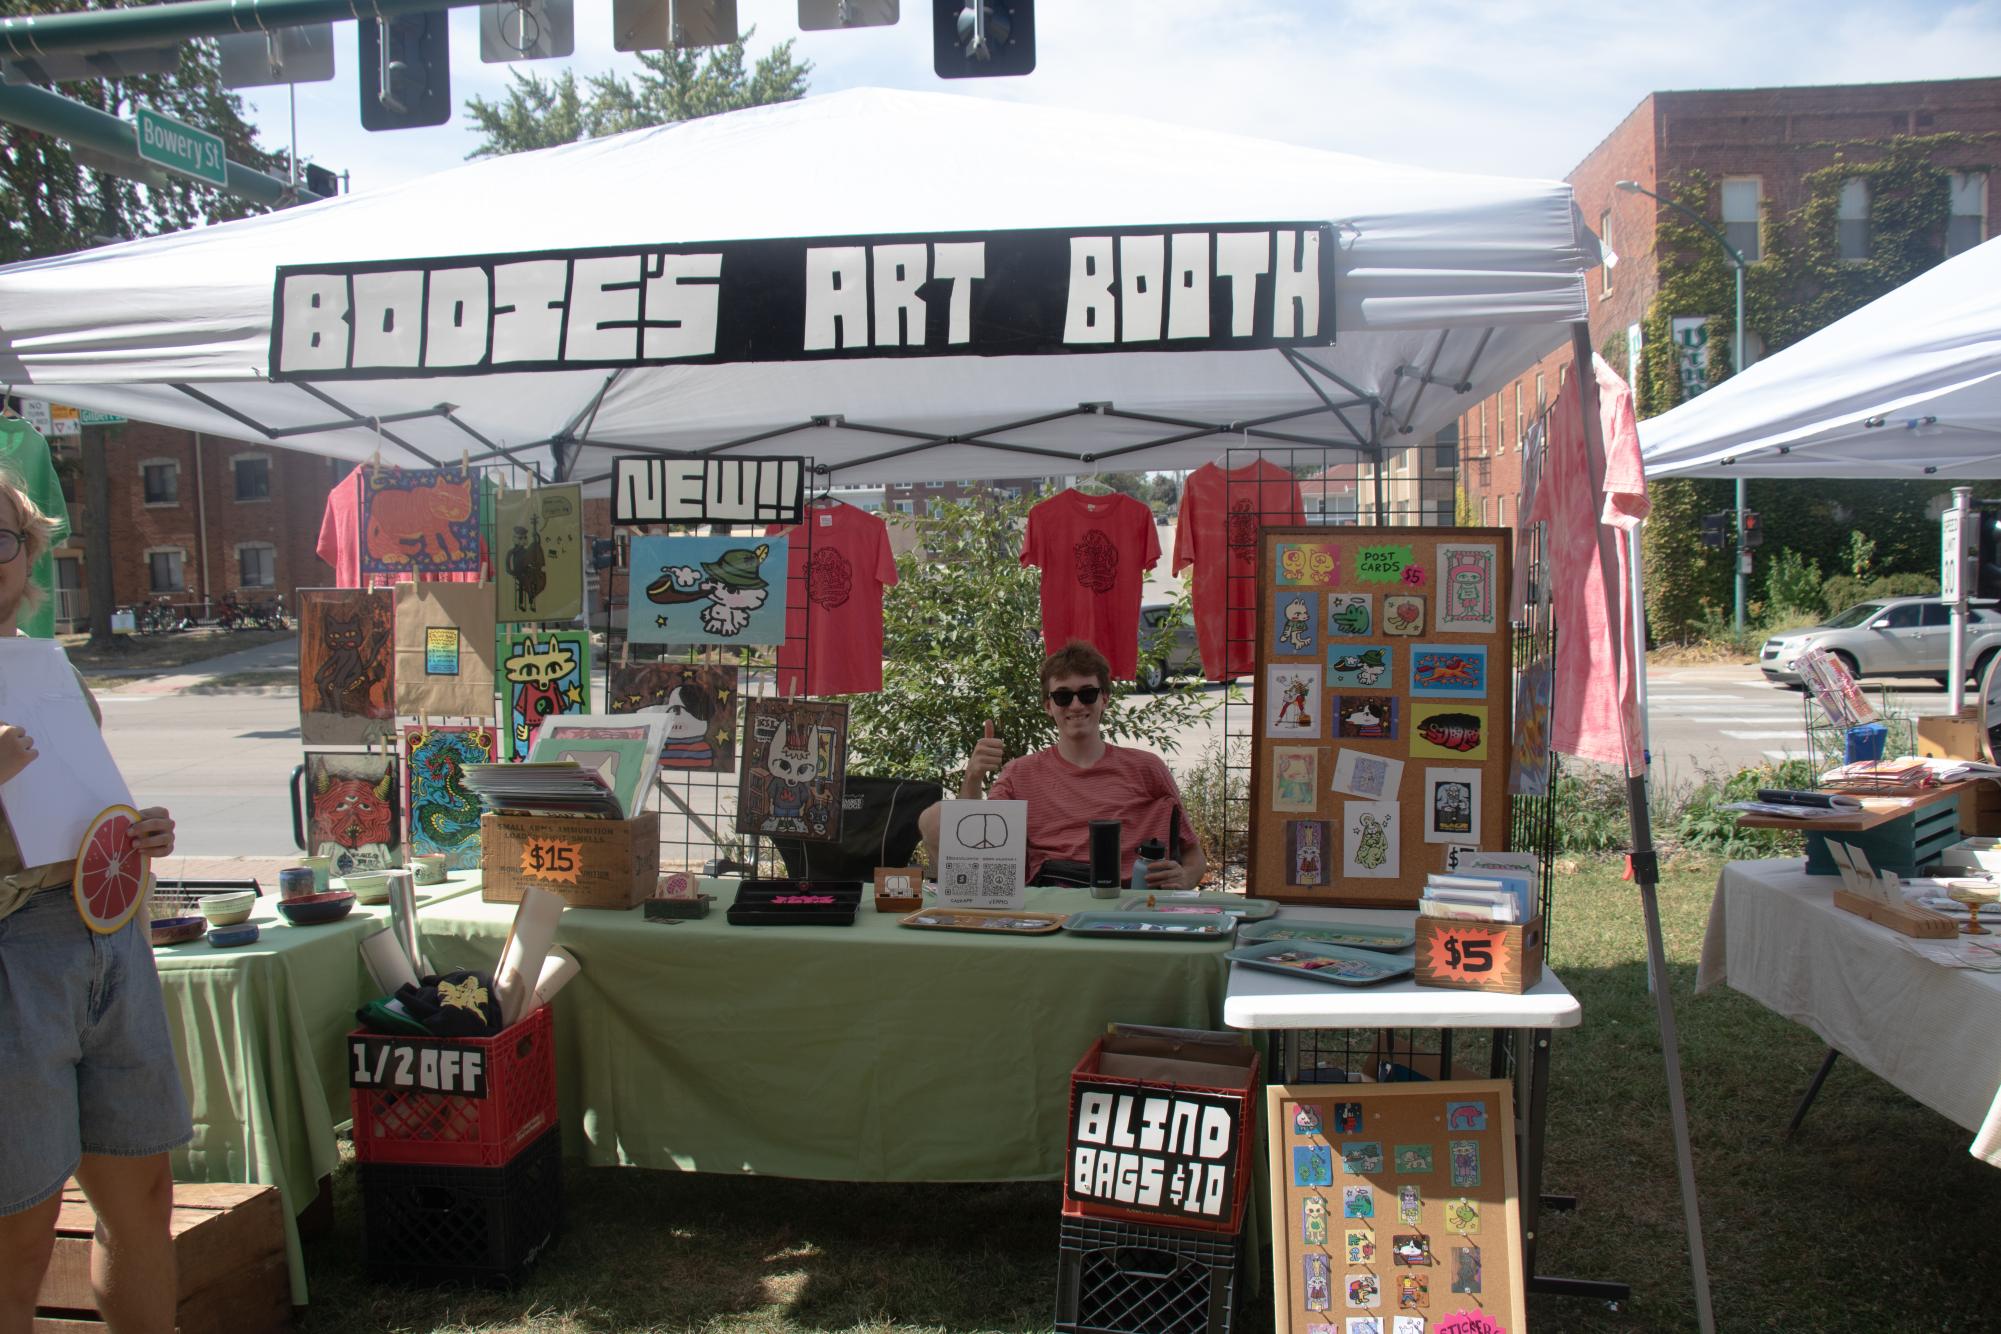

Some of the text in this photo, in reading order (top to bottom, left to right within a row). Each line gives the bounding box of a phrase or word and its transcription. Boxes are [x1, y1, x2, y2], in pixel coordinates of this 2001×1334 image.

[143, 116, 220, 170] Bowery St
[280, 230, 1319, 372] BODIE'S ART BOOTH
[617, 460, 799, 520] NEW!!
[1361, 562, 1400, 573] CARDS
[1364, 551, 1396, 562] POST
[1404, 568, 1421, 584] $5
[497, 823, 524, 832] SMALL
[529, 844, 574, 872] $15
[1443, 935, 1494, 973] $5
[353, 1043, 482, 1092] 1/2 OFF
[1077, 1091, 1231, 1159] BLIND
[1074, 1147, 1226, 1216] BAGS $10
